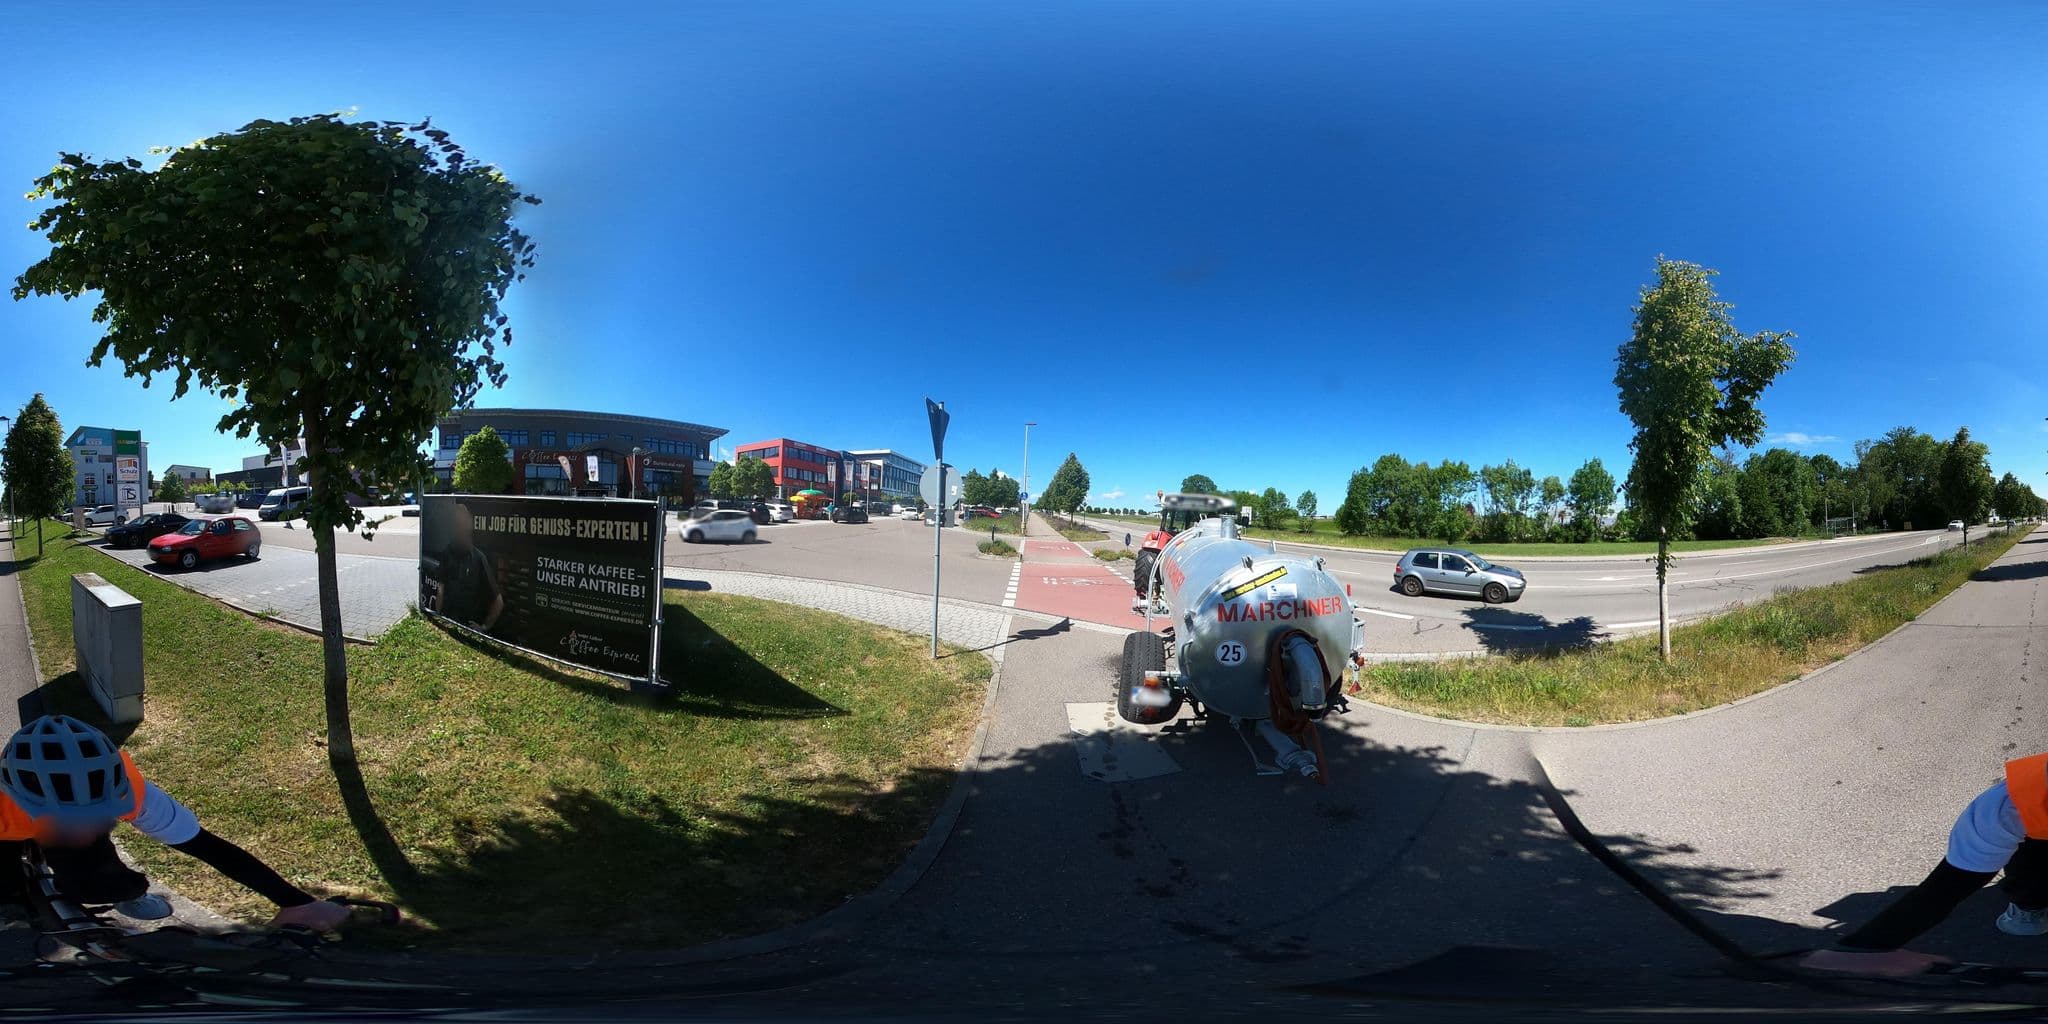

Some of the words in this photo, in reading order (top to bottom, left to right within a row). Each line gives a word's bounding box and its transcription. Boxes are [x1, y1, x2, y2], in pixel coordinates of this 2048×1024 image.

[474, 515, 486, 531] EIN
[488, 516, 506, 532] JOB
[508, 514, 527, 534] FÜR
[530, 517, 639, 541] GENUSS-EXPERTEN
[537, 556, 585, 575] STARKER
[536, 569, 575, 588] UNSER
[579, 577, 646, 599] ANTRIEB!
[1217, 595, 1342, 622] MARCHNER
[1220, 644, 1242, 662] 25
